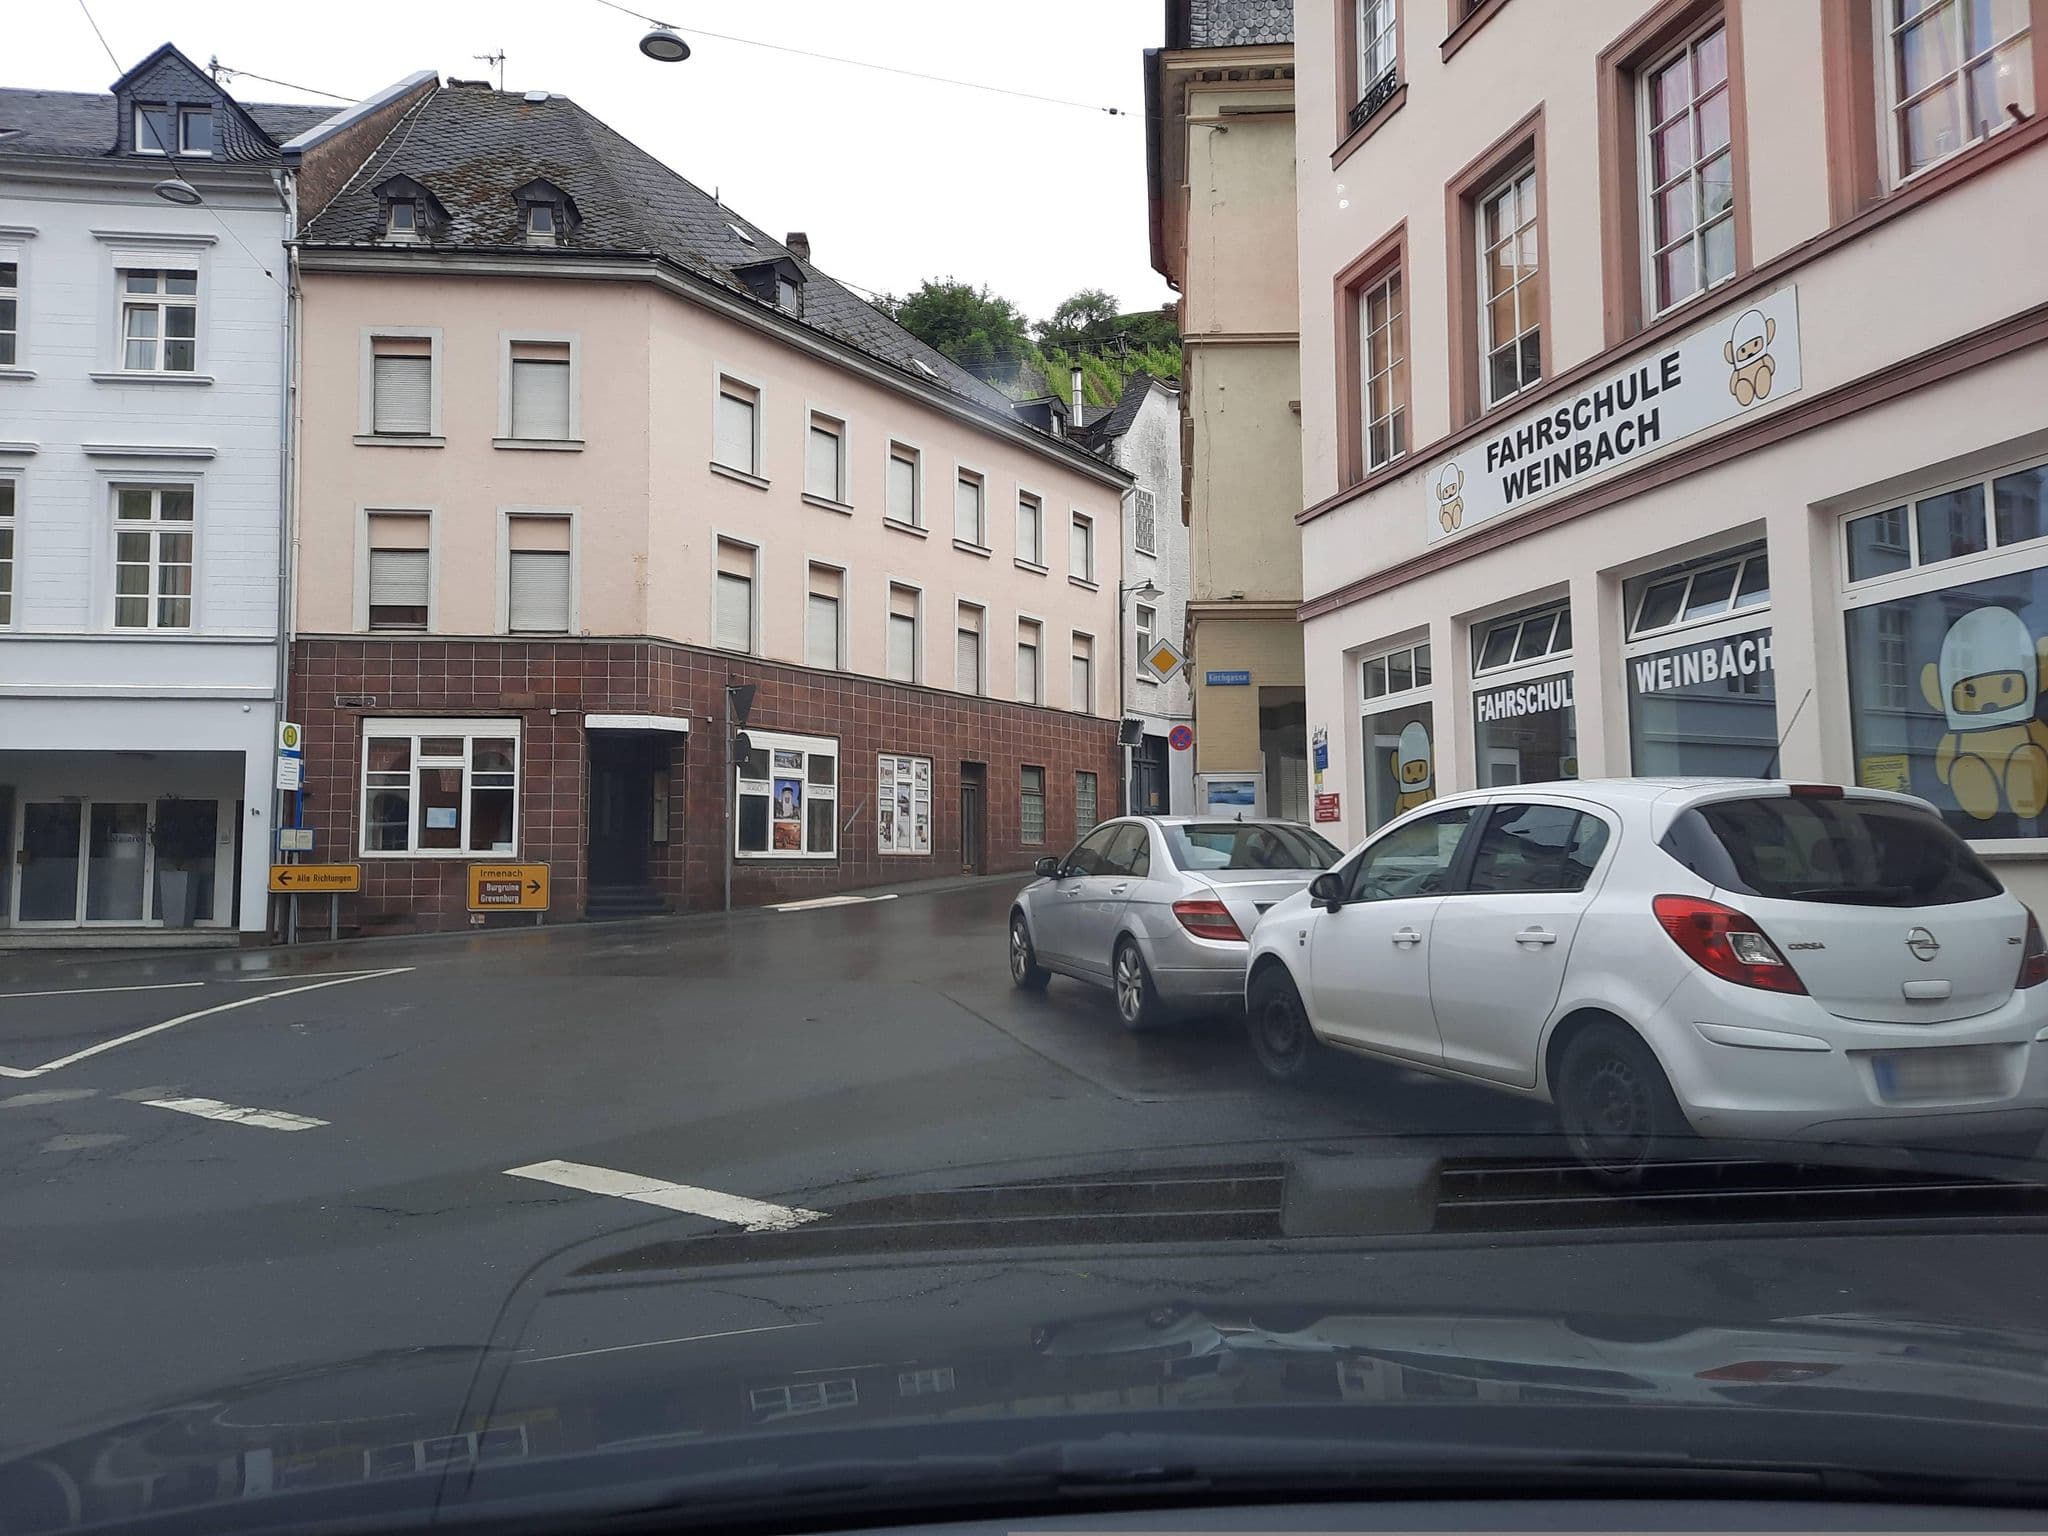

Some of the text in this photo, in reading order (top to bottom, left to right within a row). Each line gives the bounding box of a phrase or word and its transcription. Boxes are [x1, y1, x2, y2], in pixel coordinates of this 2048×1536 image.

[1486, 350, 1681, 474] FAHRSCHULE
[1502, 407, 1660, 504] WEINBACH
[1635, 636, 1775, 694] WEINBACH
[1477, 678, 1575, 723] FAHRSCHUL
[296, 872, 352, 884] Alle Richtungen
[480, 869, 523, 877] Irmenach
[480, 894, 519, 904] Grevenburg
[486, 883, 519, 893] Burgruine
